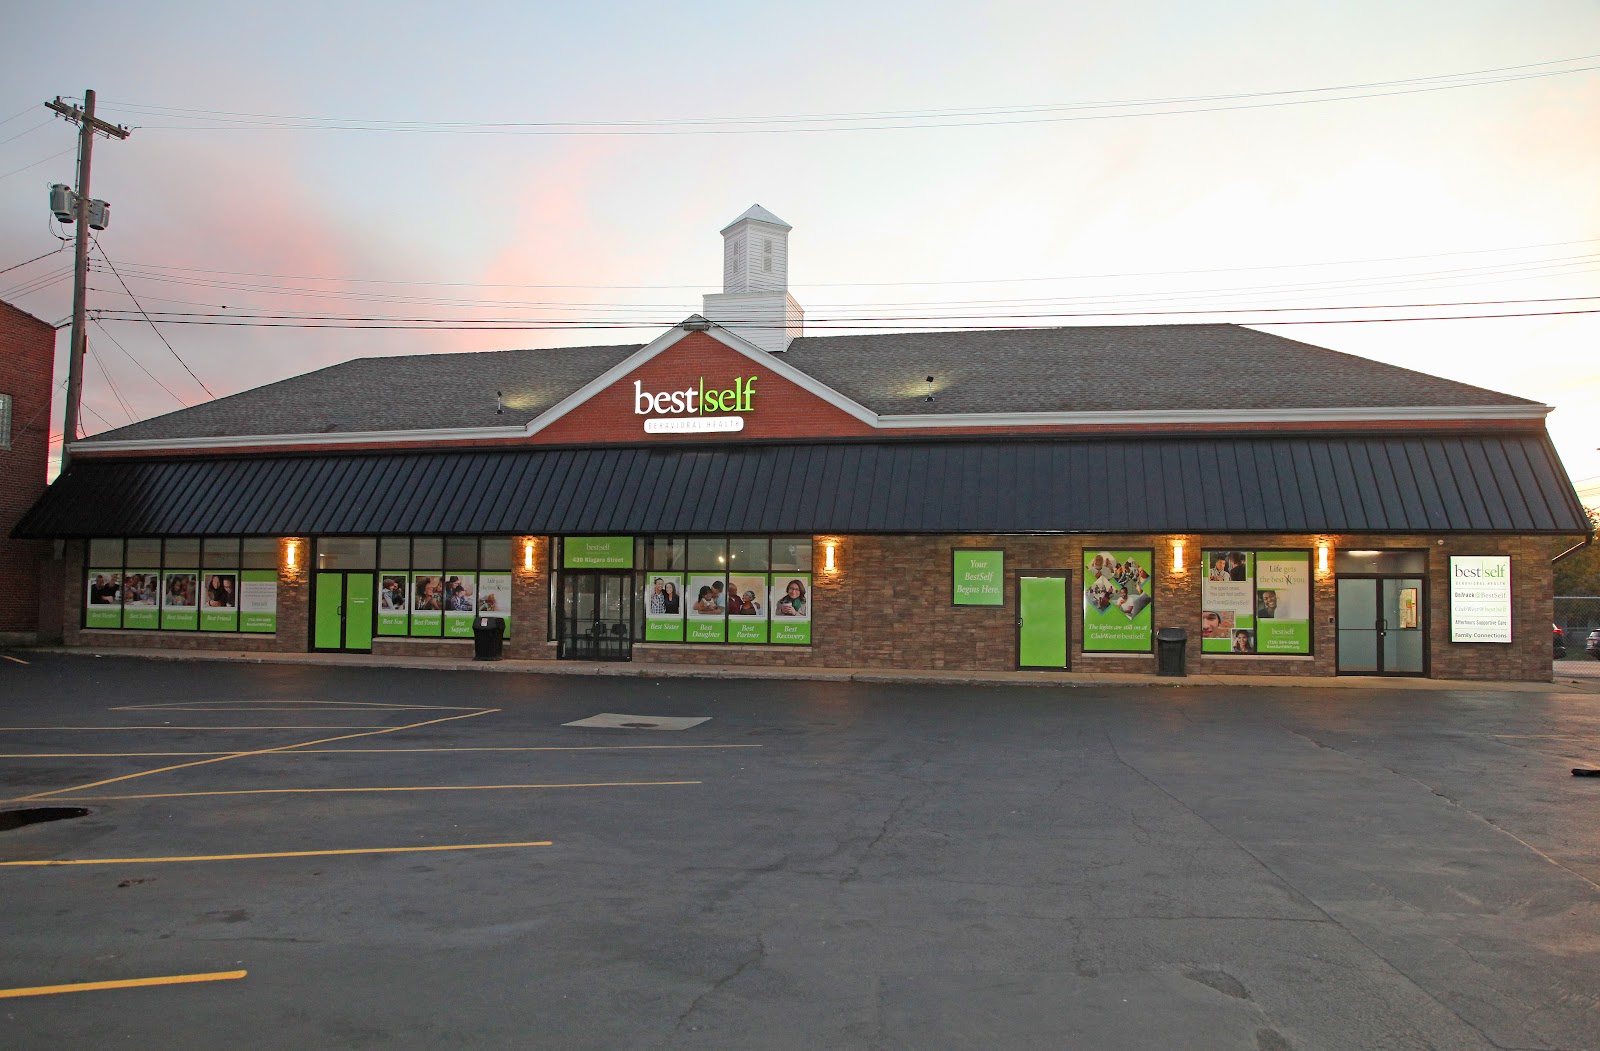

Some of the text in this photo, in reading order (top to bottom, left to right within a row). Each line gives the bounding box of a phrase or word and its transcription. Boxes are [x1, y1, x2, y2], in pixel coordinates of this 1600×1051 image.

[648, 420, 740, 430] BEHAVIORAL HEALTH
[584, 556, 606, 564] Niagara
[970, 559, 988, 568] Your
[1269, 564, 1297, 574] Life gets
[964, 571, 995, 583] BestSelf
[1271, 575, 1284, 583] best
[956, 584, 1000, 595] Begins Here.
[451, 626, 470, 634] Support
[1100, 623, 1113, 631] lights
[692, 630, 721, 639] Daughter
[776, 632, 806, 640] Recovery
